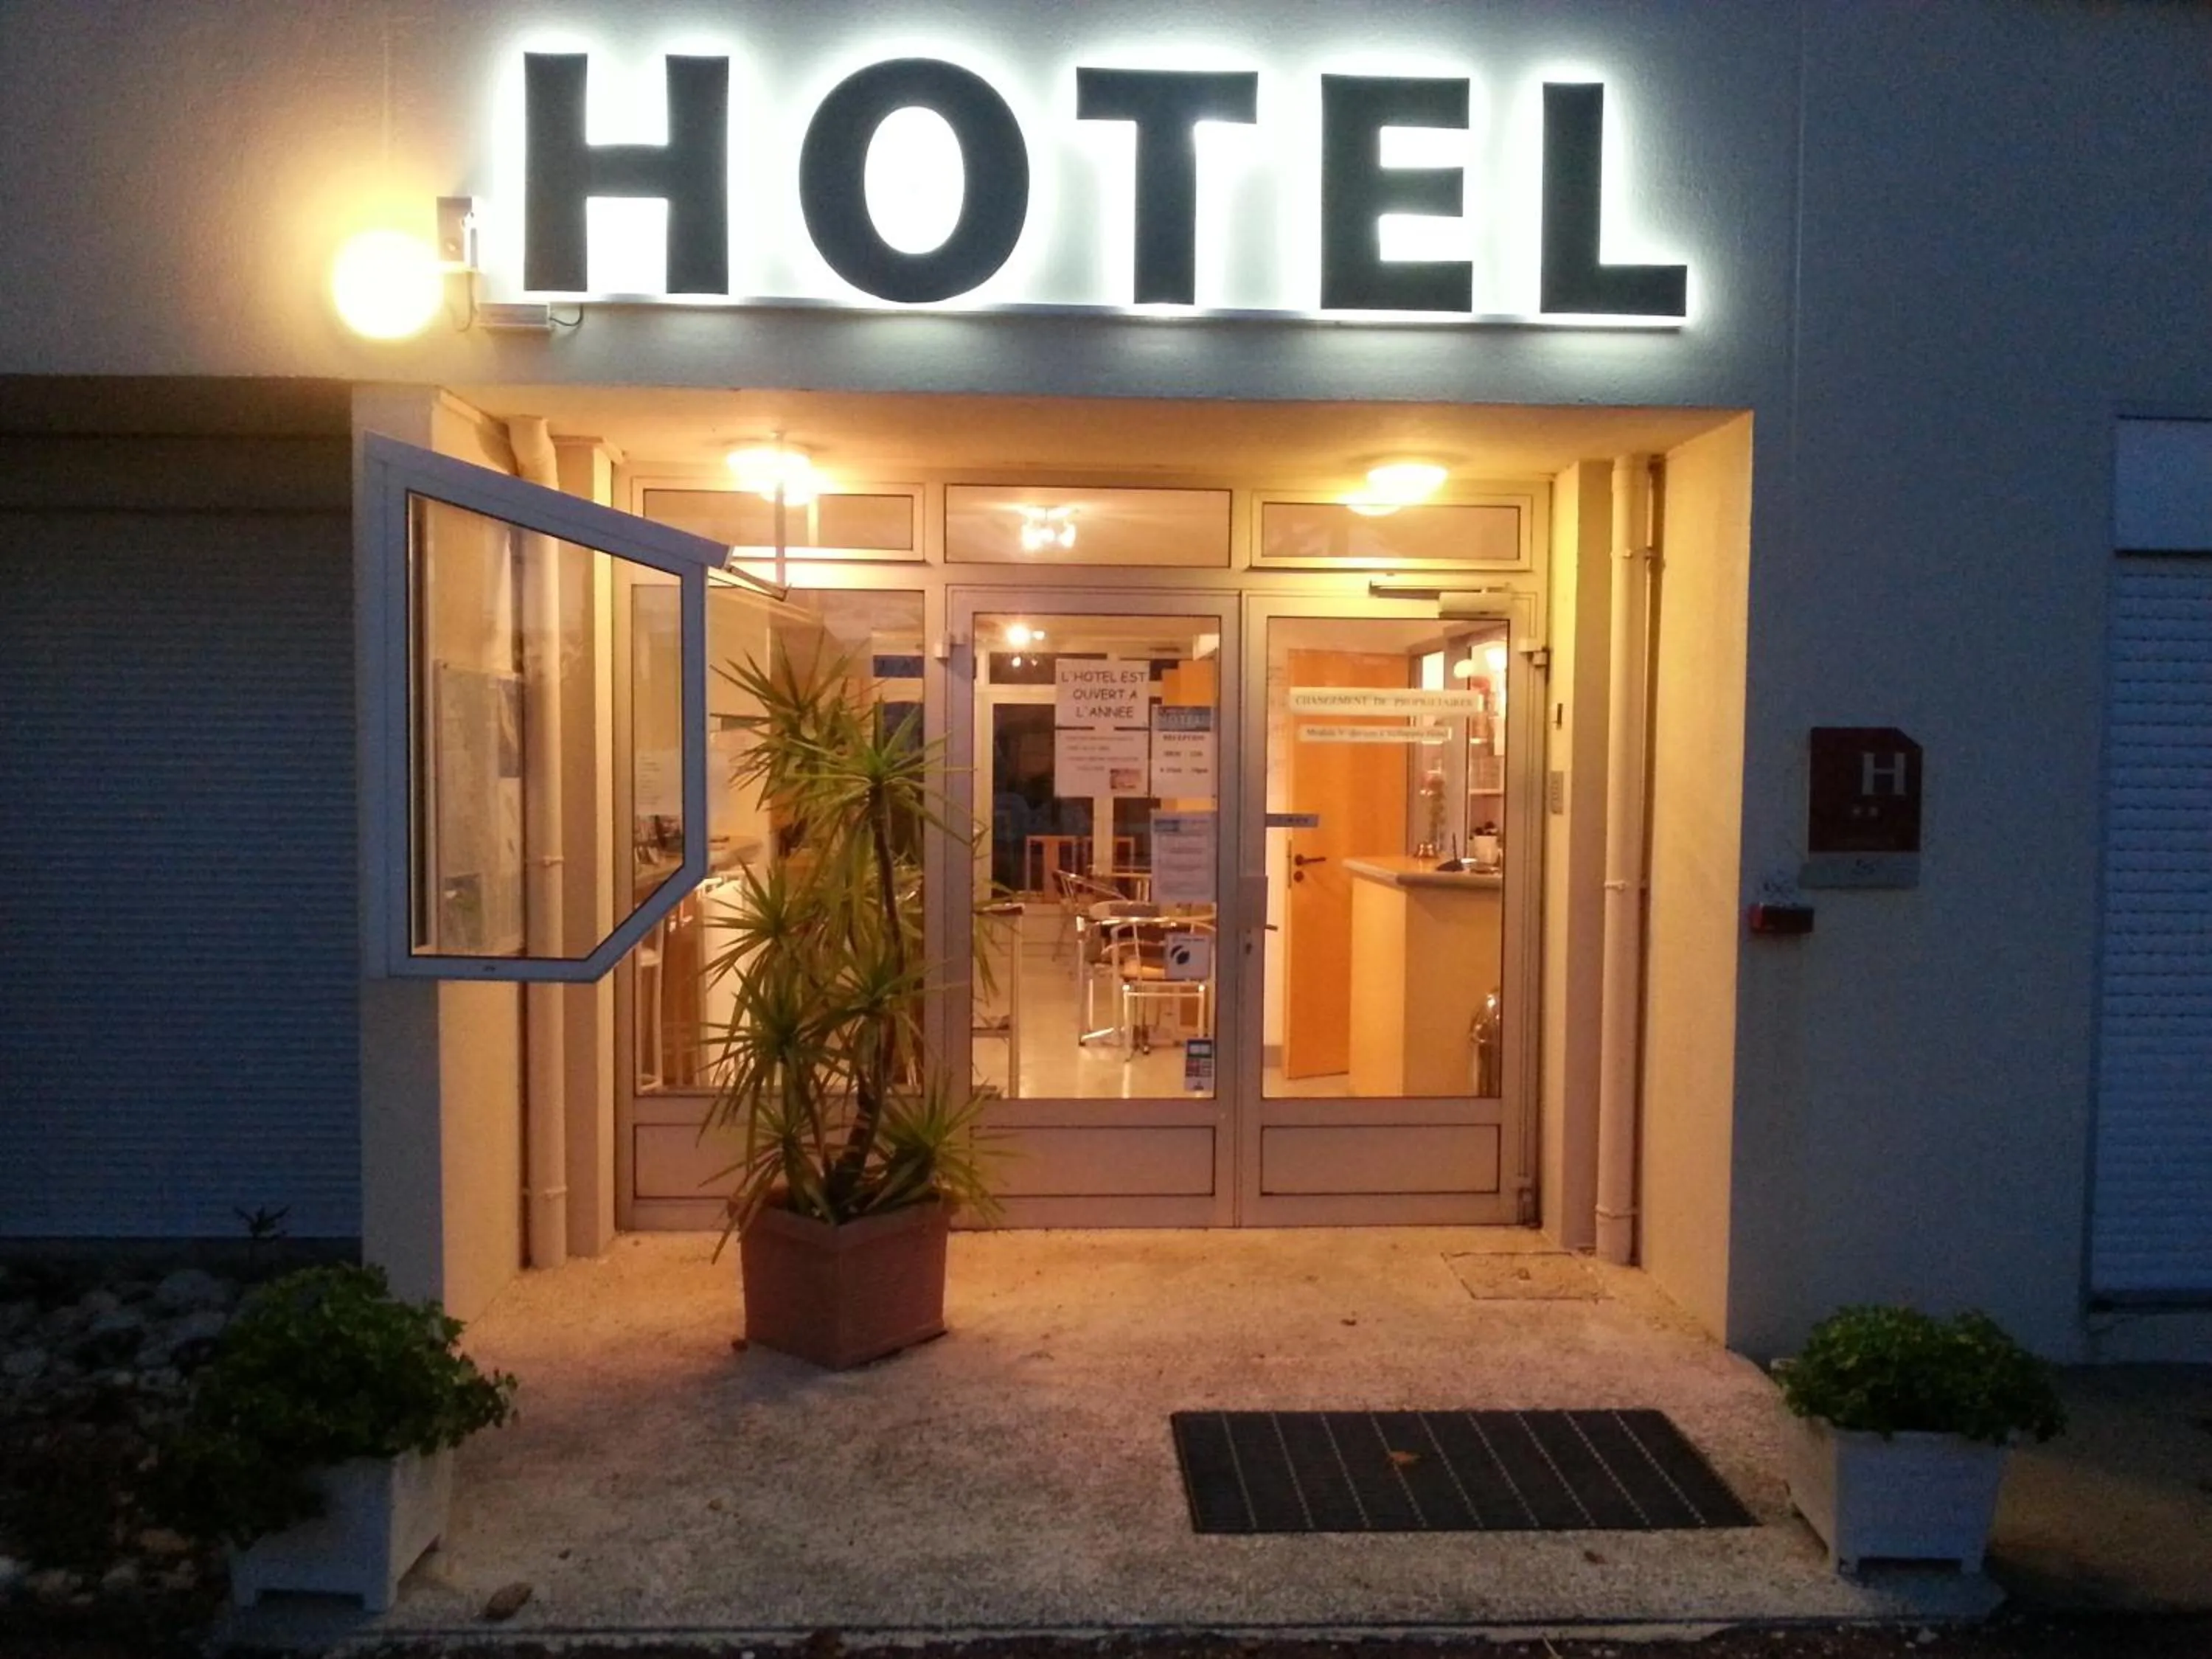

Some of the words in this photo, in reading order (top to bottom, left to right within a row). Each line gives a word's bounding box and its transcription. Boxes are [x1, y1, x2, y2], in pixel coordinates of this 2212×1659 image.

[524, 51, 1687, 316] HOTEL
[1061, 670, 1116, 683] L'HOTEL
[1121, 670, 1146, 683] EST
[1073, 688, 1124, 700] OUVERT
[1862, 752, 1906, 796] H
